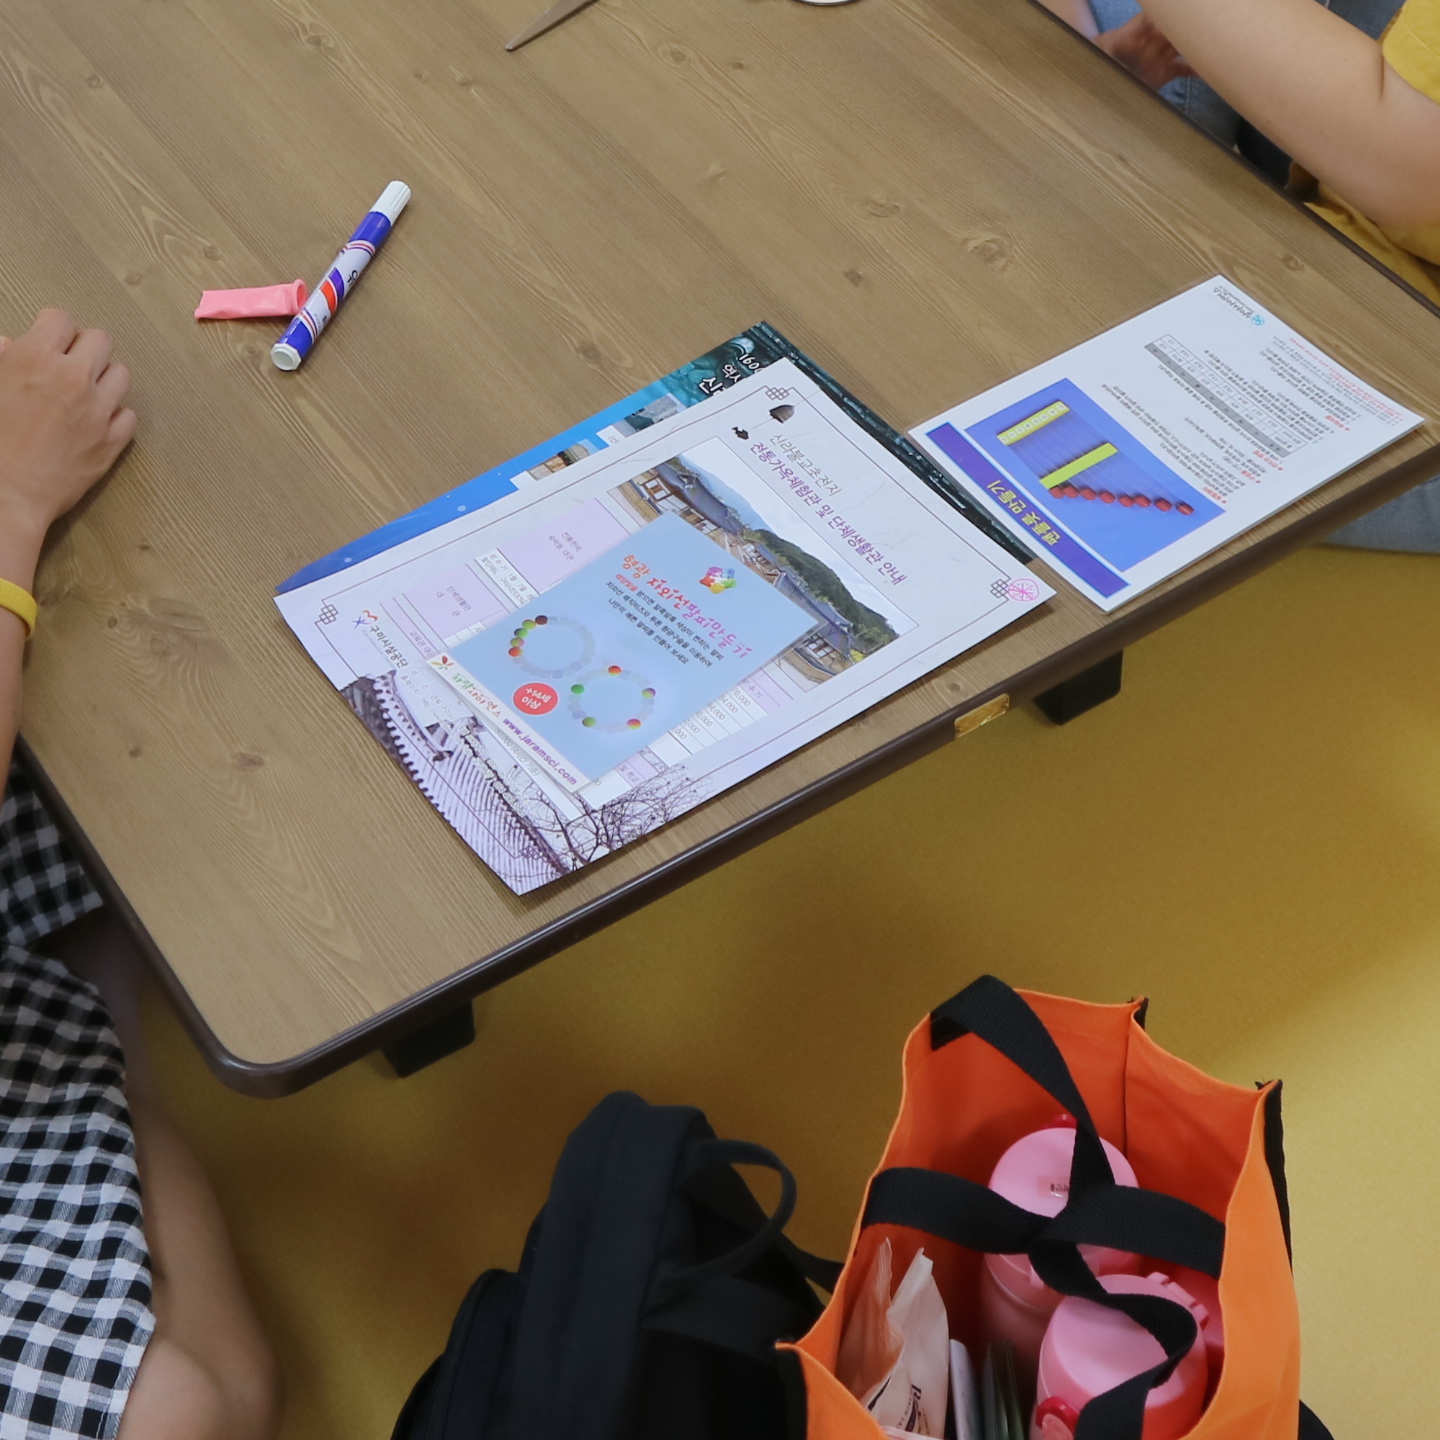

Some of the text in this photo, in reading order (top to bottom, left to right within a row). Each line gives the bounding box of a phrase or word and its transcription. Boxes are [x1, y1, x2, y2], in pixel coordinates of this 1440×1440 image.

[765, 431, 845, 498] 신라불교초전지
[745, 440, 908, 586] 전통가옥체험관 및 단체생활관 안내
[984, 478, 1065, 547] 팬플룻 만들기
[615, 552, 653, 580] 형광
[364, 623, 411, 669] 구미시설공단
[519, 694, 542, 710] 이상
[499, 716, 580, 787] www.jaramsci.com
